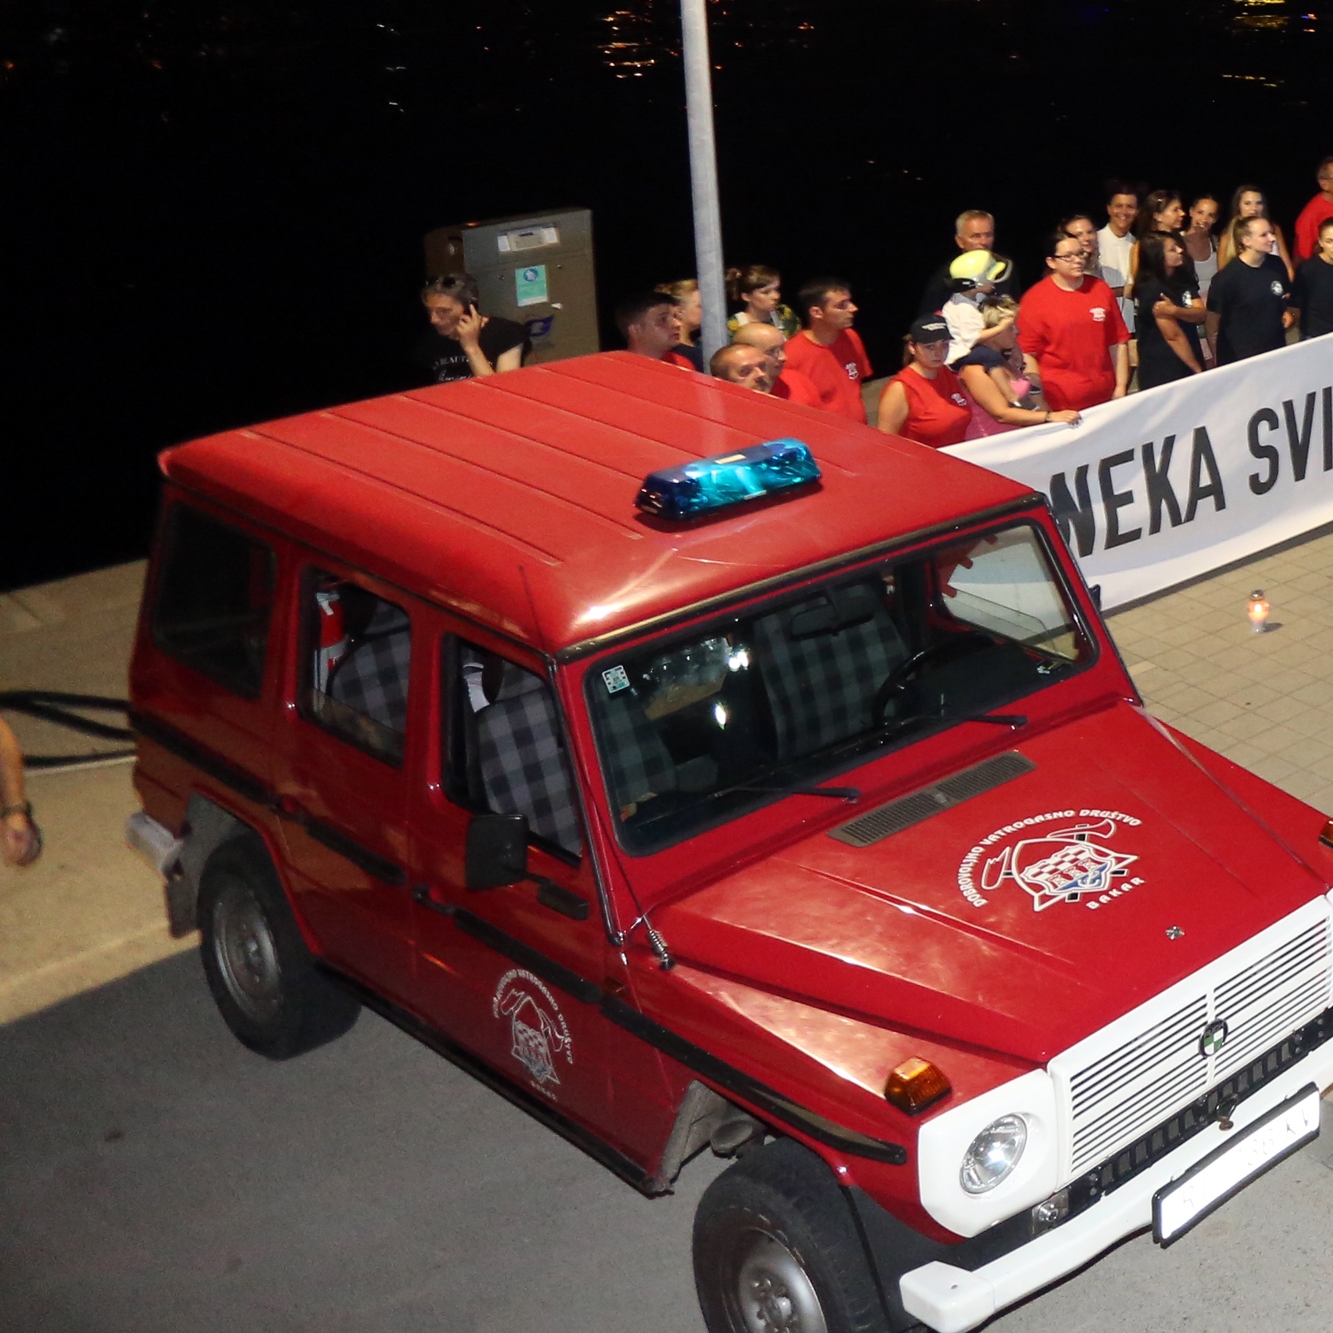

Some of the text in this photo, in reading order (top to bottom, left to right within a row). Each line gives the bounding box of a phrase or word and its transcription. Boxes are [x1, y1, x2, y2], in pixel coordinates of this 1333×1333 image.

[1048, 425, 1227, 557] NEKA
[957, 808, 1142, 908] DOBROVOLJNO VATROGASNO DRUŠTVO
[1085, 876, 1146, 910] BAKAR
